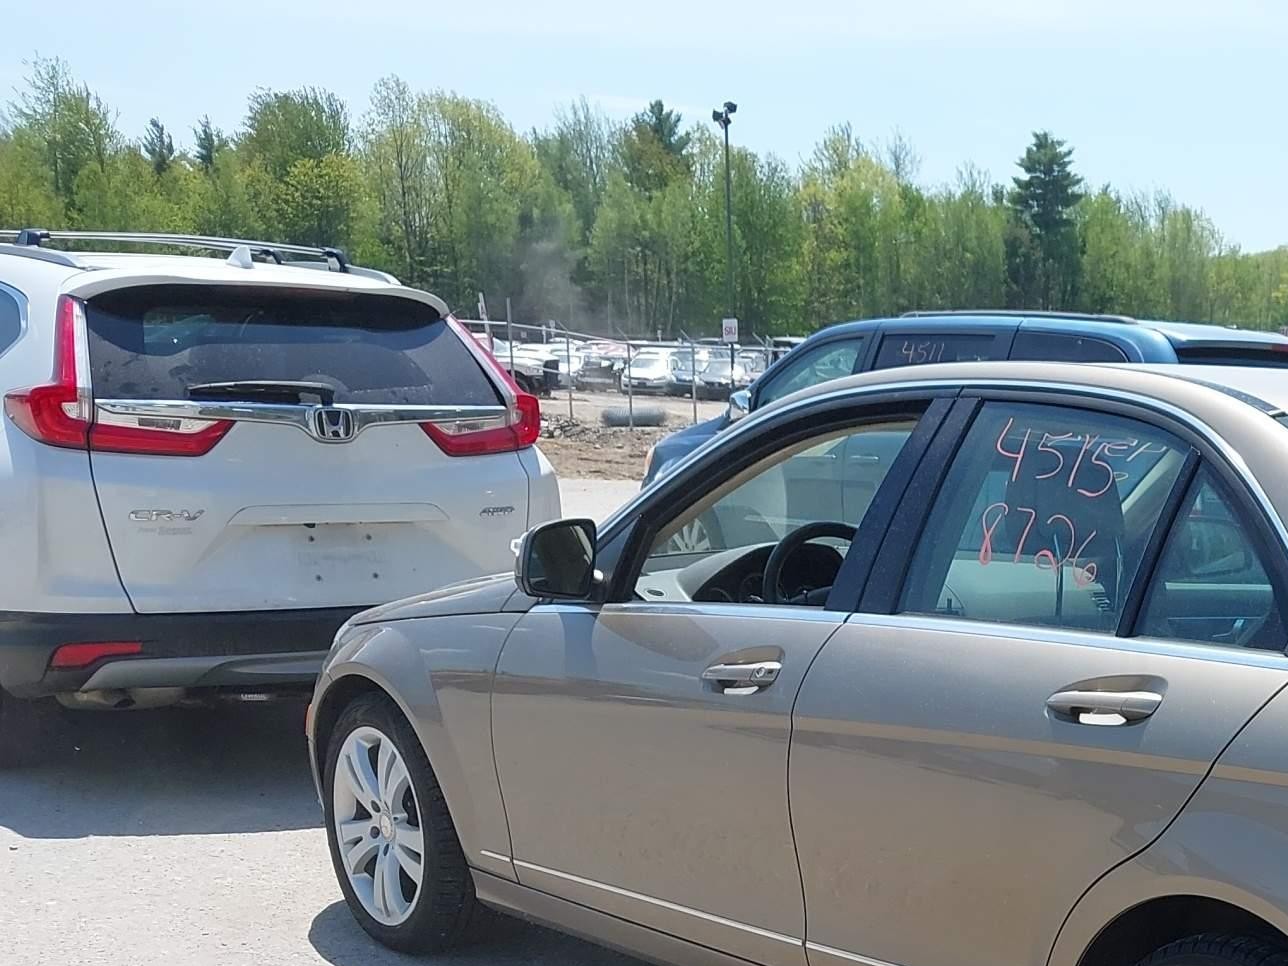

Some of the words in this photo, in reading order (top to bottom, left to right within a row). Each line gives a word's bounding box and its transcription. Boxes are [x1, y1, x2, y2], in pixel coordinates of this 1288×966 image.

[902, 340, 945, 363] 4511
[996, 417, 1114, 498] 4515
[128, 509, 205, 521] CR-V
[979, 502, 1097, 588] 8726
